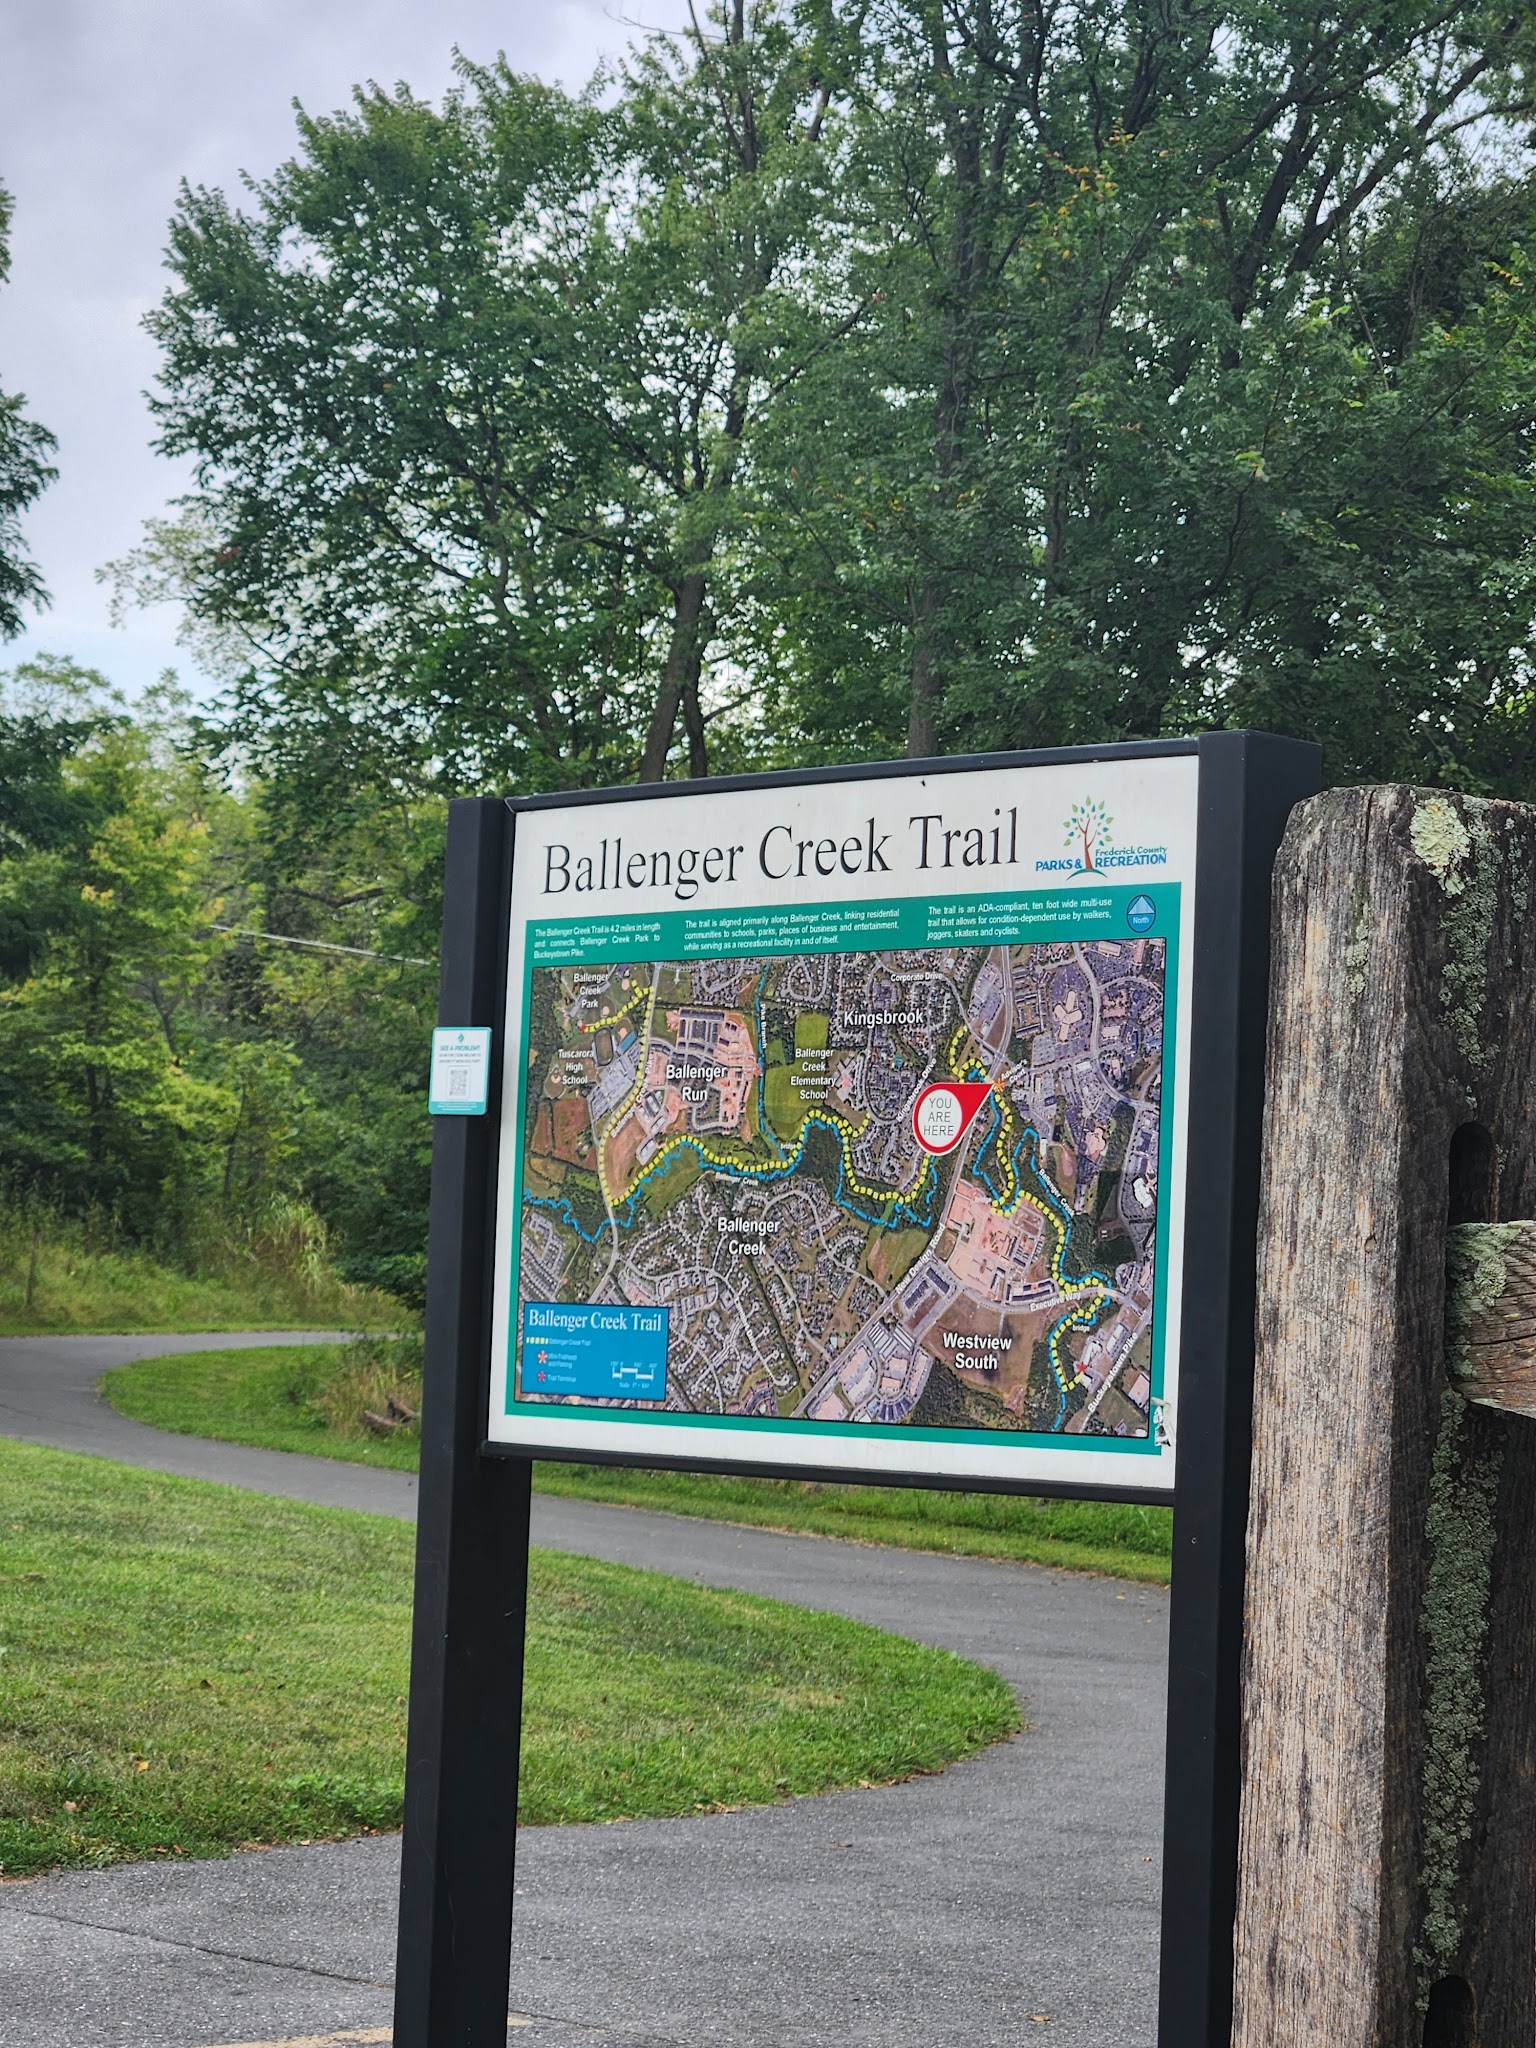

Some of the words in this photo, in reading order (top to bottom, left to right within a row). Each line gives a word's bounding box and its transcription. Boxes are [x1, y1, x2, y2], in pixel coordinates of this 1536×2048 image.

[540, 837, 744, 900] Ballenger
[759, 817, 893, 879] Creek
[908, 807, 1020, 869] Trail
[1095, 846, 1135, 856] Frederick
[1137, 846, 1168, 855] County
[1035, 859, 1073, 871] PARKS
[1074, 858, 1083, 869] &
[1095, 854, 1167, 868] RECREATION
[928, 906, 941, 915] The
[943, 905, 956, 914] trail
[958, 904, 965, 913] is
[977, 902, 1030, 913] ADA-compliant,
[1032, 902, 1044, 910] ten
[1046, 901, 1060, 909] foot
[1061, 900, 1079, 908] wide
[1081, 898, 1112, 907] multi-use
[685, 920, 697, 928] The
[698, 919, 711, 928] trail
[711, 919, 717, 927] is
[719, 917, 741, 928] aligned
[742, 916, 769, 927] primarily
[770, 915, 788, 925] along
[790, 914, 819, 923] Ballenger
[844, 911, 865, 920] linking
[866, 909, 900, 919] residential
[927, 918, 940, 927] trail
[941, 917, 955, 926] that
[955, 917, 977, 926] allows
[977, 916, 988, 925] for
[989, 912, 1057, 925] condition-dependent
[1072, 911, 1081, 921] by
[1083, 910, 1112, 920] walkers,
[1133, 916, 1149, 924] North
[535, 929, 546, 937] The
[547, 927, 573, 938] Ballenger
[573, 926, 591, 935] Creek
[591, 925, 604, 934] Trail
[604, 925, 609, 933] is
[620, 924, 636, 932] miles
[642, 922, 661, 932] length
[684, 930, 722, 940] communities
[723, 930, 730, 938] to
[731, 928, 757, 937] schools,
[758, 927, 778, 937] parks,
[779, 926, 800, 936] places
[801, 925, 809, 934] of
[809, 924, 837, 933] business
[839, 923, 852, 931] and
[853, 921, 899, 931] entertainment,
[927, 931, 954, 941] joggers,
[954, 929, 979, 938] skaters
[980, 927, 993, 936] and
[994, 926, 1020, 937] cyclists.
[534, 940, 546, 948] and
[549, 939, 575, 947] connects
[580, 937, 607, 946] Ballenger
[612, 935, 630, 944] Creek
[634, 934, 649, 942] Park
[684, 943, 700, 951] while
[700, 941, 723, 951] serving
[737, 939, 773, 948] recreational
[774, 937, 794, 947] facility
[794, 937, 801, 945] in
[801, 936, 814, 945] and
[814, 936, 822, 944] of
[573, 973, 608, 983] Ballenger
[890, 973, 923, 983] Corporate
[924, 972, 943, 981] Drive
[579, 986, 601, 996] Creek
[581, 999, 599, 1008] Park
[844, 1008, 924, 1029] Kingsbrook
[558, 1049, 595, 1059] Tuscarora
[795, 1048, 834, 1060] Ballenger
[565, 1062, 583, 1073] High
[666, 1064, 727, 1082] Ballenger
[802, 1061, 826, 1071] Creek
[562, 1075, 588, 1085] School
[790, 1076, 837, 1087] Elementary
[1009, 1069, 1026, 1084] Court
[682, 1087, 708, 1101] Run
[800, 1089, 829, 1100] School
[895, 1079, 926, 1122] Kingsbrook
[921, 1057, 937, 1080] Drive
[928, 1097, 952, 1109] YOU
[928, 1111, 951, 1123] ARE
[923, 1125, 955, 1136] HERE
[715, 1172, 741, 1184] Ballenger
[742, 1177, 759, 1186] Creek
[1038, 1168, 1061, 1198] Ballenger
[1060, 1197, 1075, 1218] Creek
[718, 1217, 781, 1236] Ballenger
[728, 1240, 767, 1256] Creek
[895, 1275, 912, 1294] New
[909, 1249, 934, 1277] Design
[930, 1223, 947, 1250] Road
[1030, 1297, 1064, 1312] Executive
[1064, 1291, 1081, 1303] Way
[529, 1309, 588, 1332] Ballenger
[590, 1311, 628, 1330] Creek
[631, 1313, 662, 1332] Trail
[1072, 1324, 1090, 1333] bridge
[942, 1332, 1012, 1350] Westview
[955, 1353, 998, 1370] South
[1087, 1352, 1127, 1413] Buckeystown
[1123, 1331, 1139, 1355] Pike
